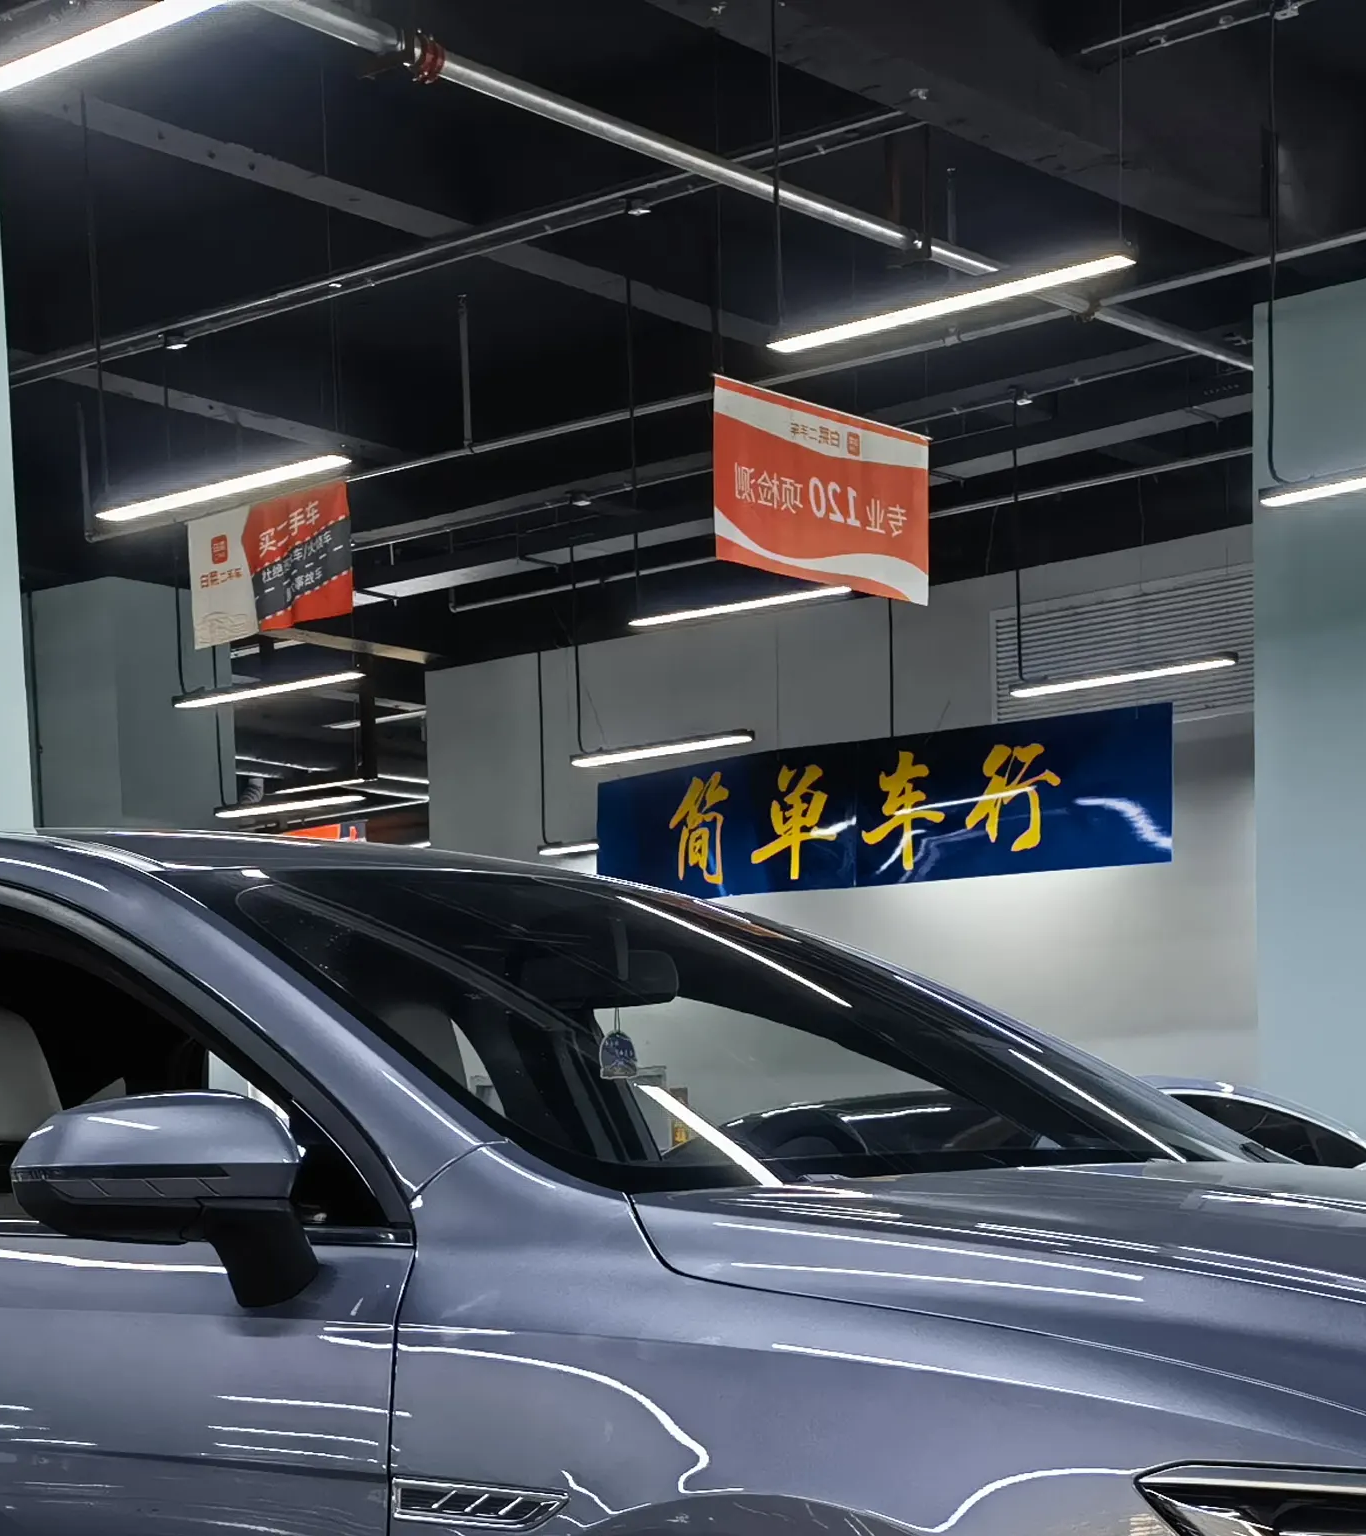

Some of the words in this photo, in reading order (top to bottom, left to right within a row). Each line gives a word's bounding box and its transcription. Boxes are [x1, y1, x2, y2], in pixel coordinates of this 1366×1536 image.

[259, 501, 321, 559] 买二手车
[669, 743, 1062, 886] 简单车行
